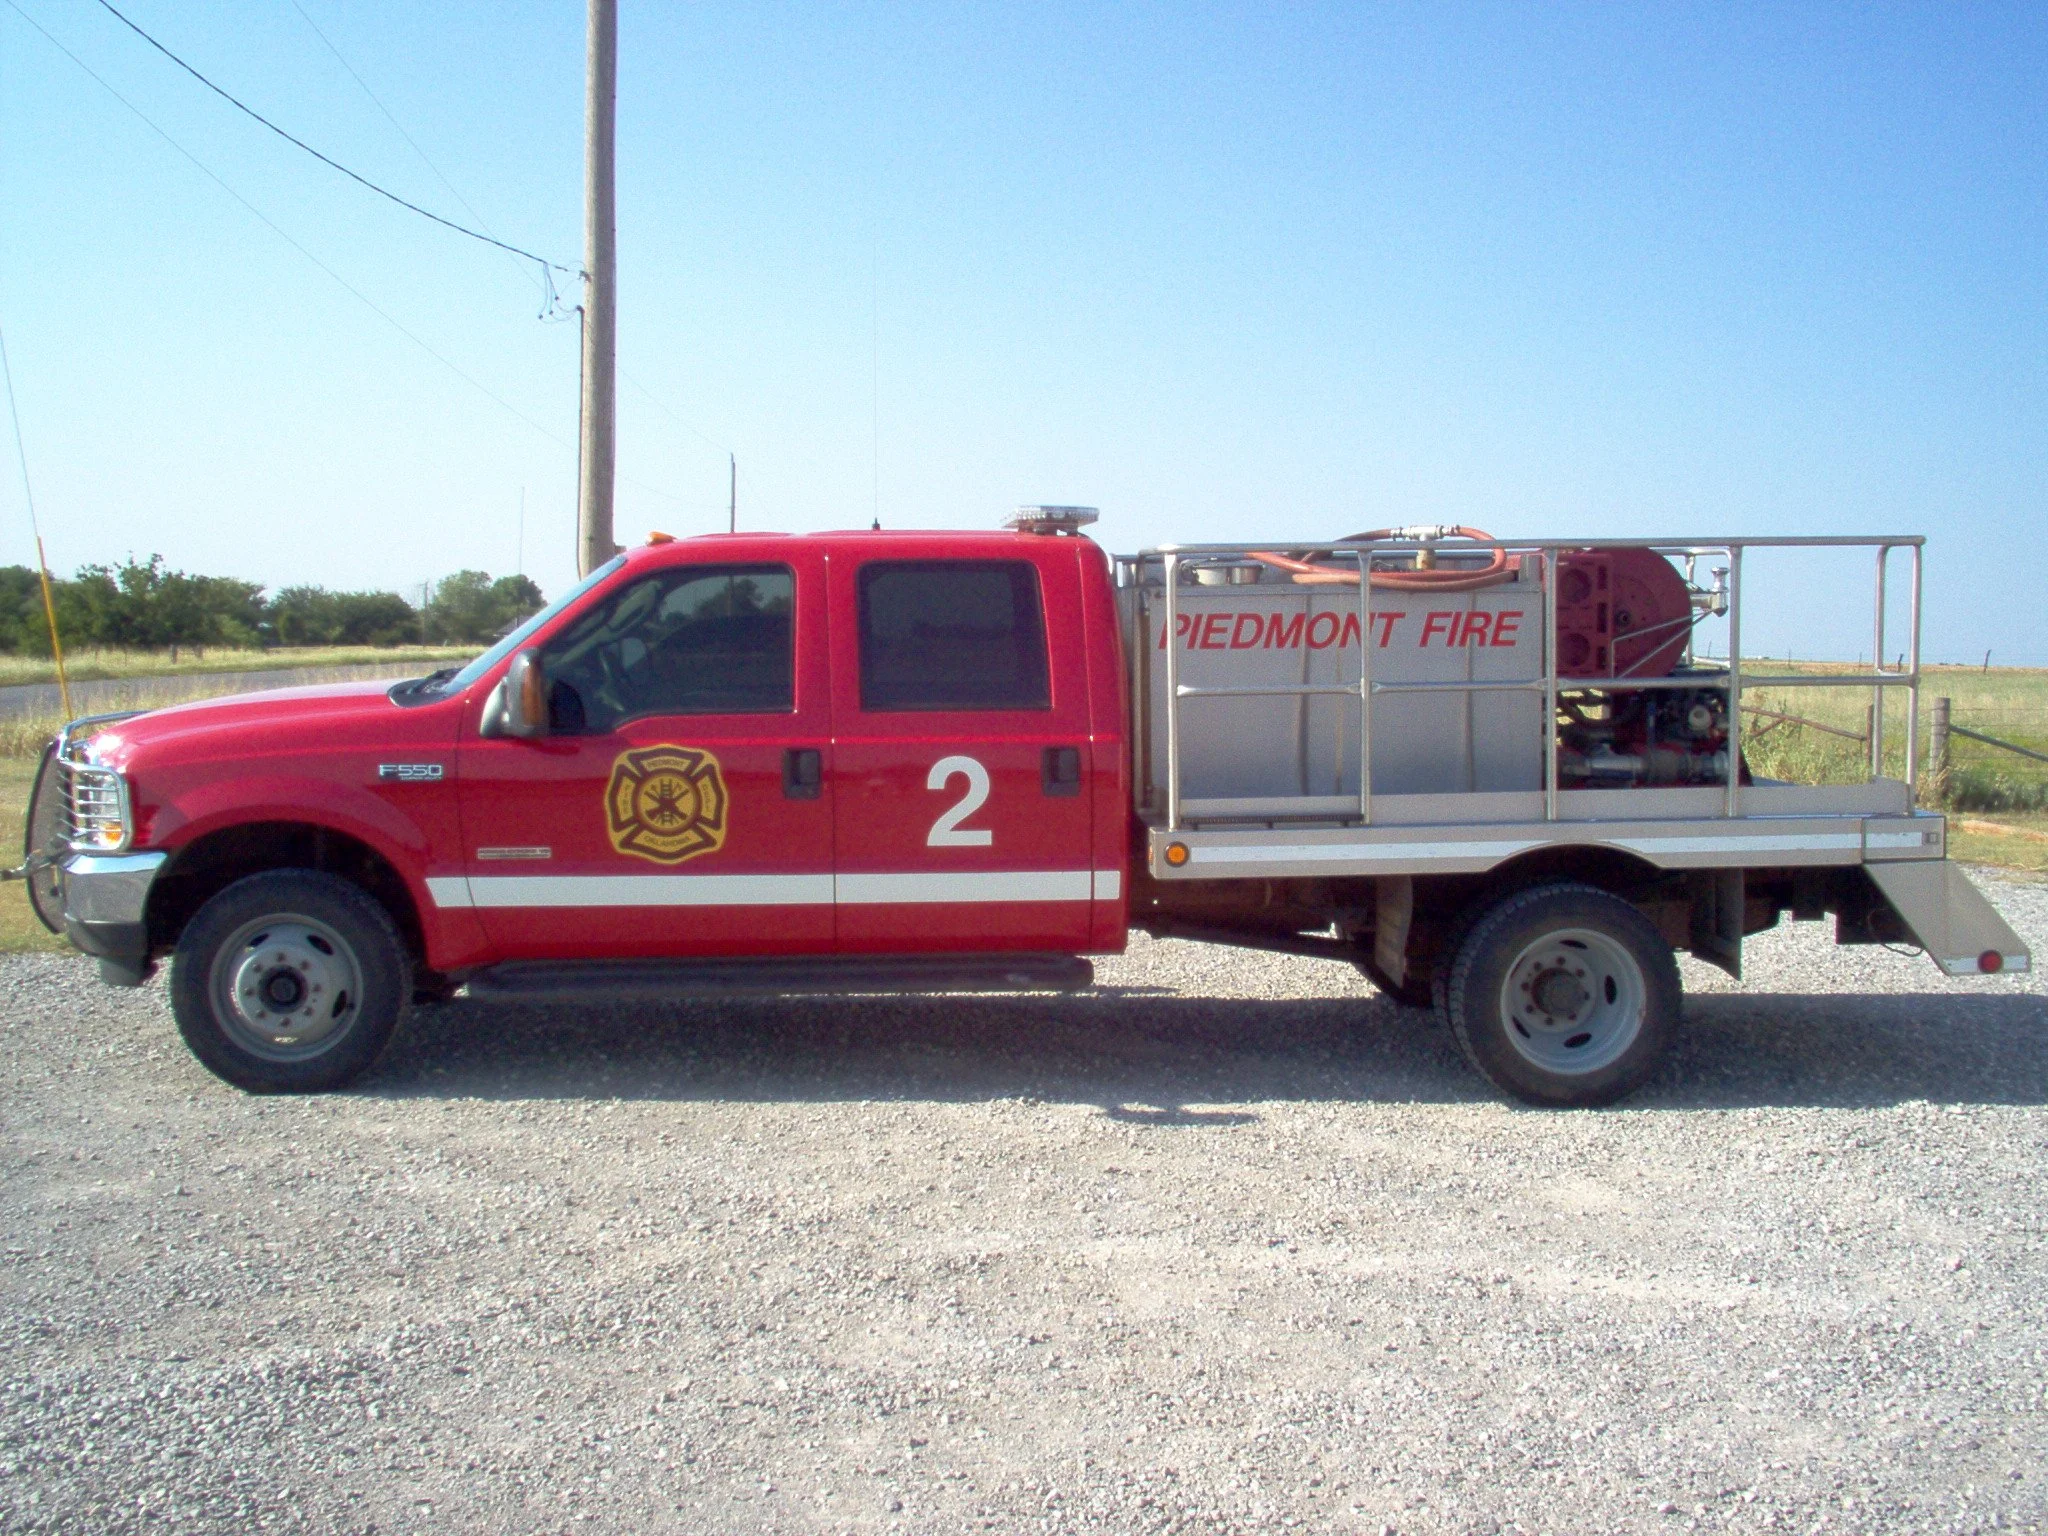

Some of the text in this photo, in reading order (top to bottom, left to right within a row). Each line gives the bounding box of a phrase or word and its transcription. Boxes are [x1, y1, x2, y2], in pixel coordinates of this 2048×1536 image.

[1158, 611, 1523, 650] PIEDMONT FIRE
[927, 755, 992, 846] 2
